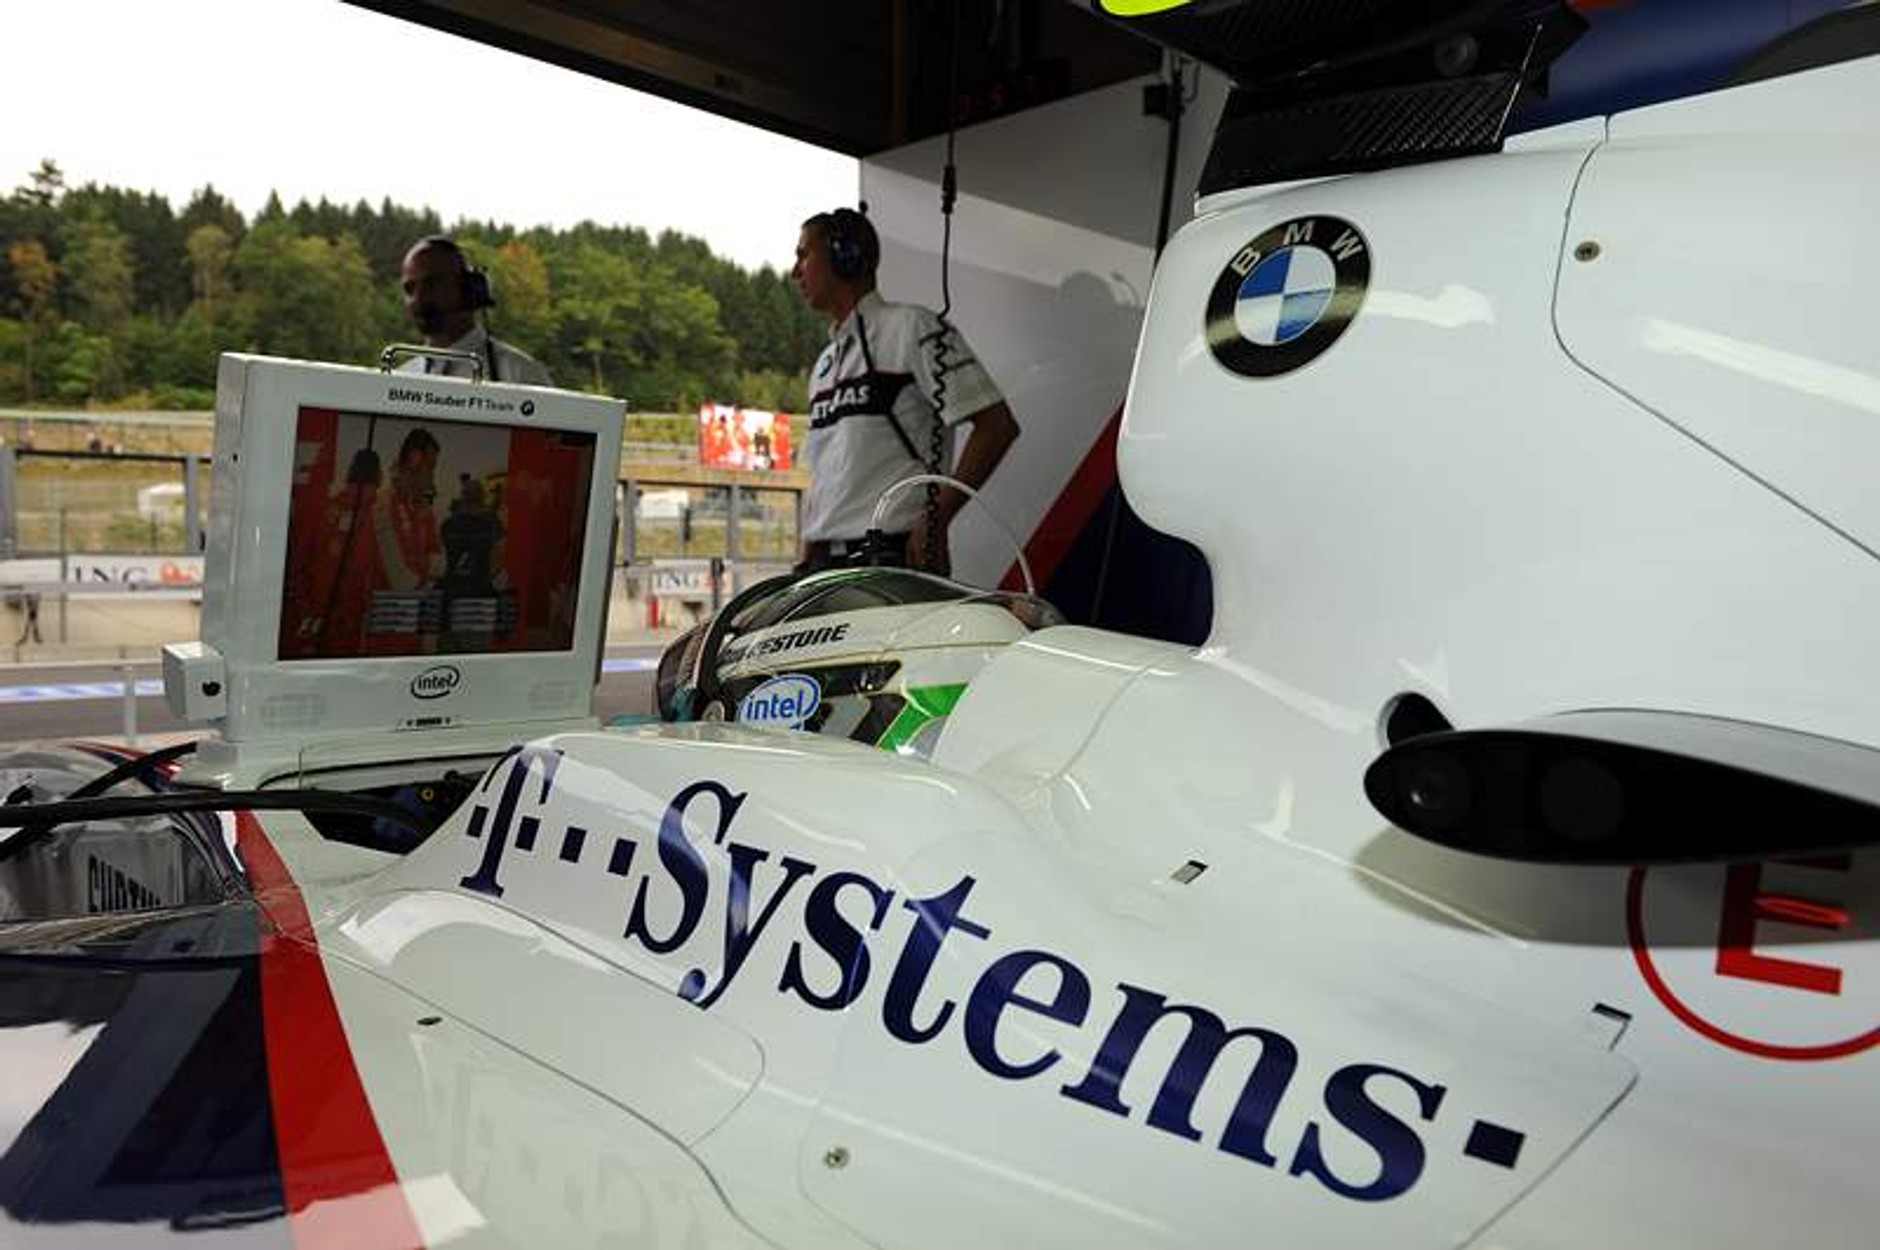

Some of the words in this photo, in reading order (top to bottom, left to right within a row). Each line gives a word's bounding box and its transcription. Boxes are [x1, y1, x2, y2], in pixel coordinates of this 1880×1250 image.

[1231, 220, 1363, 276] BMW
[388, 389, 421, 402] BMW
[424, 393, 465, 407] Sauber
[468, 397, 483, 409] F1
[486, 400, 514, 411] Team
[75, 566, 148, 584] ING
[747, 690, 804, 720] intel
